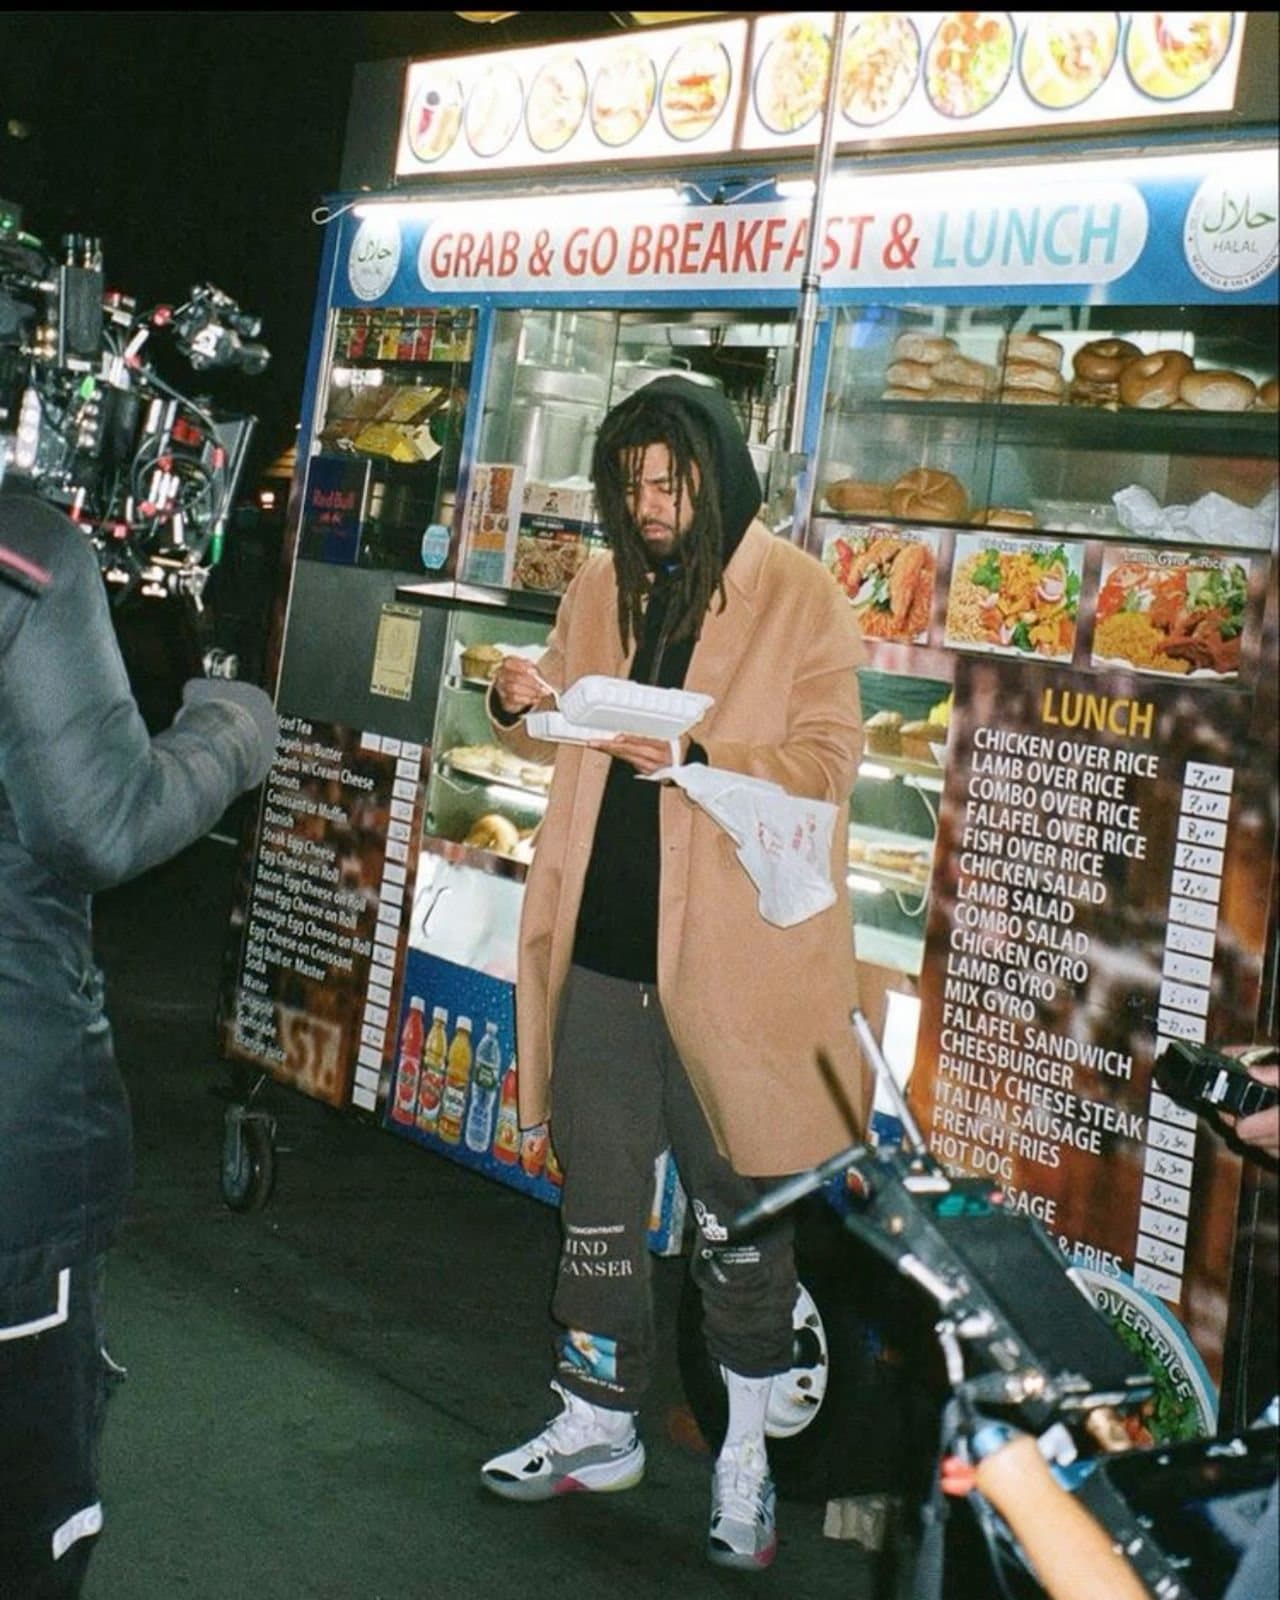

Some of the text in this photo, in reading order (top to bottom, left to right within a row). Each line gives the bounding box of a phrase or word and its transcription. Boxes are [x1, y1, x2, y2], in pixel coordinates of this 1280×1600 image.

[431, 204, 1122, 278] GRAB & GO BREAKFAST & LUNCH
[1214, 240, 1257, 253] HALAL
[296, 719, 312, 735] Tea
[1043, 688, 1155, 739] LUNCH
[311, 762, 340, 781] Cream
[341, 769, 375, 791] Cheese
[972, 752, 1126, 800] LAMB OVER RICE
[974, 727, 1160, 779] CHICKEN OVER RICE
[267, 788, 307, 812] Croissant
[307, 804, 317, 813] or
[269, 770, 300, 790] Donuts
[968, 777, 1140, 831] COMBO OVER RICE
[265, 807, 294, 829] Danish
[965, 802, 1147, 859] FALAFEL OVER RICE
[259, 846, 339, 883] Egg Cheese on Roll
[262, 828, 336, 862] Steak Egg Cheese
[962, 827, 1104, 878] FISH OVER RICE
[257, 865, 366, 912] Bacon Egg Cheese on Roll
[957, 878, 1075, 925] LAMB SALAD
[959, 853, 1106, 905] CHICKEN SALAD
[252, 902, 371, 956] Sausage Egg Cheese on Roll
[255, 883, 357, 930] Ham Egg Cheese on Roll
[954, 903, 1089, 956] COMBO SALAD
[245, 953, 267, 973] Soda
[247, 940, 264, 958] Red
[265, 946, 281, 966] Bull
[282, 957, 292, 967] or
[249, 921, 353, 971] Egg Cheese on Croissant
[950, 928, 1088, 984] CHICKEN GYRO
[243, 973, 269, 993] Water
[944, 979, 1035, 1023] MIX GYRO
[947, 953, 1056, 1001] LAMB GYRO
[940, 1029, 1073, 1089] CHEESBURGER
[943, 1004, 1132, 1080] FALAFEL SANDWICH
[934, 1081, 1102, 1155] ITALIAN SAUSAGE
[938, 1055, 1000, 1093] PHILLY
[1005, 1074, 1076, 1118] CHEESE
[1081, 1100, 1145, 1141] STEAK
[929, 1130, 969, 1161] HOT
[972, 1146, 1013, 1179] DOG
[932, 1105, 1060, 1168] FRENCH FRIES
[560, 1259, 632, 1277] ANSER
[1059, 1235, 1070, 1257] &
[1072, 1241, 1122, 1279] FRIES
